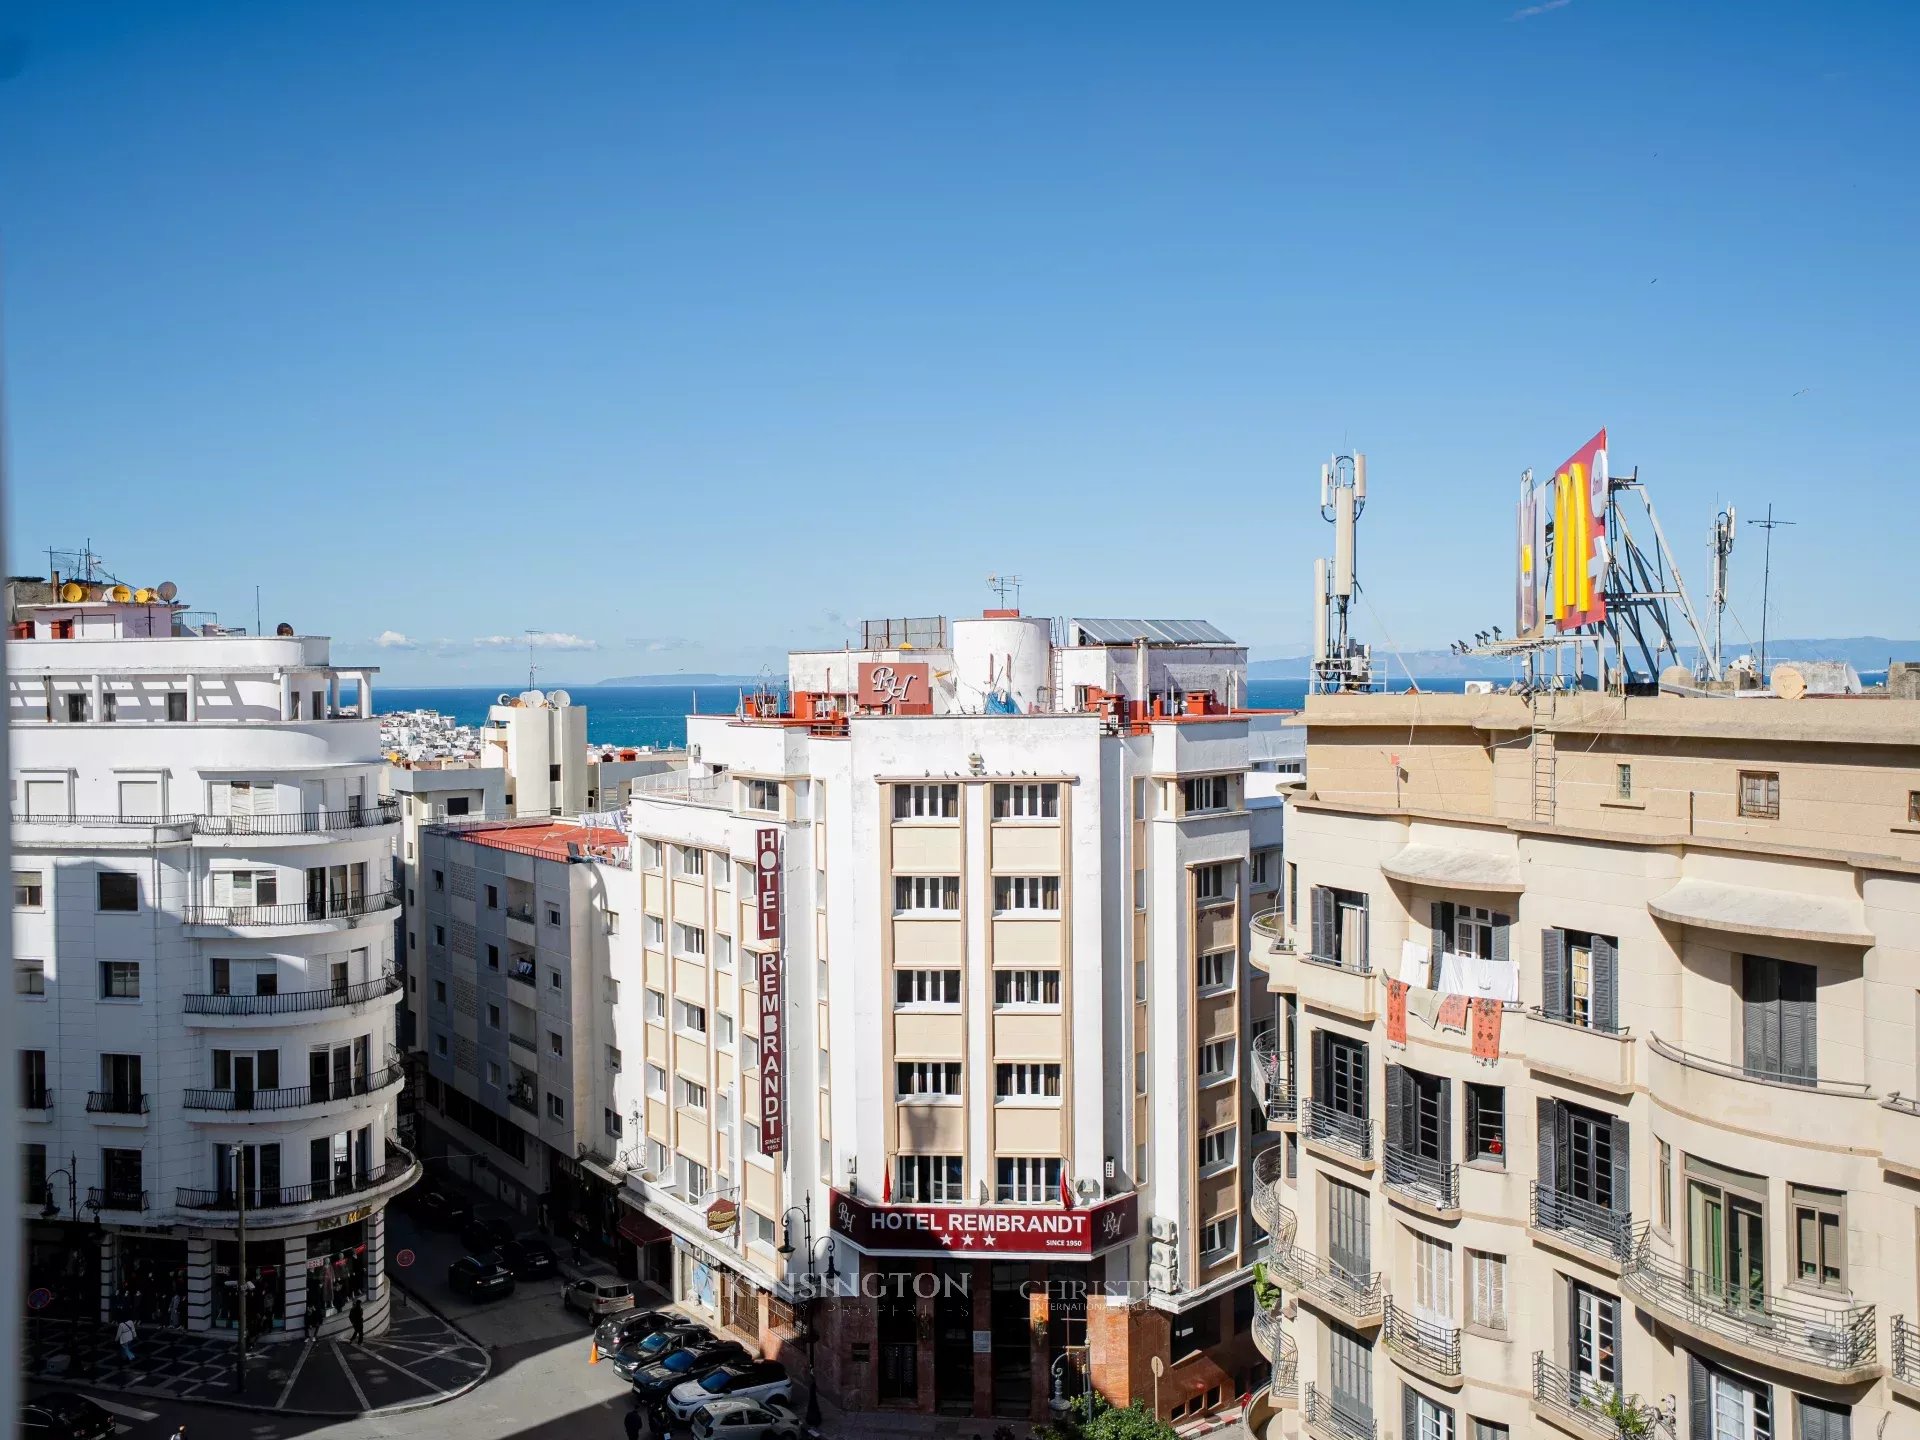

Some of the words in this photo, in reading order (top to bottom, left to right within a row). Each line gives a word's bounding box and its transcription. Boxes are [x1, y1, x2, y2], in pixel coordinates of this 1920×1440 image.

[760, 831, 777, 932] HOTEL
[761, 953, 779, 1135] REMBRANDT
[871, 1212, 943, 1231] HOTEL
[948, 1213, 1087, 1233] REMBRANDT
